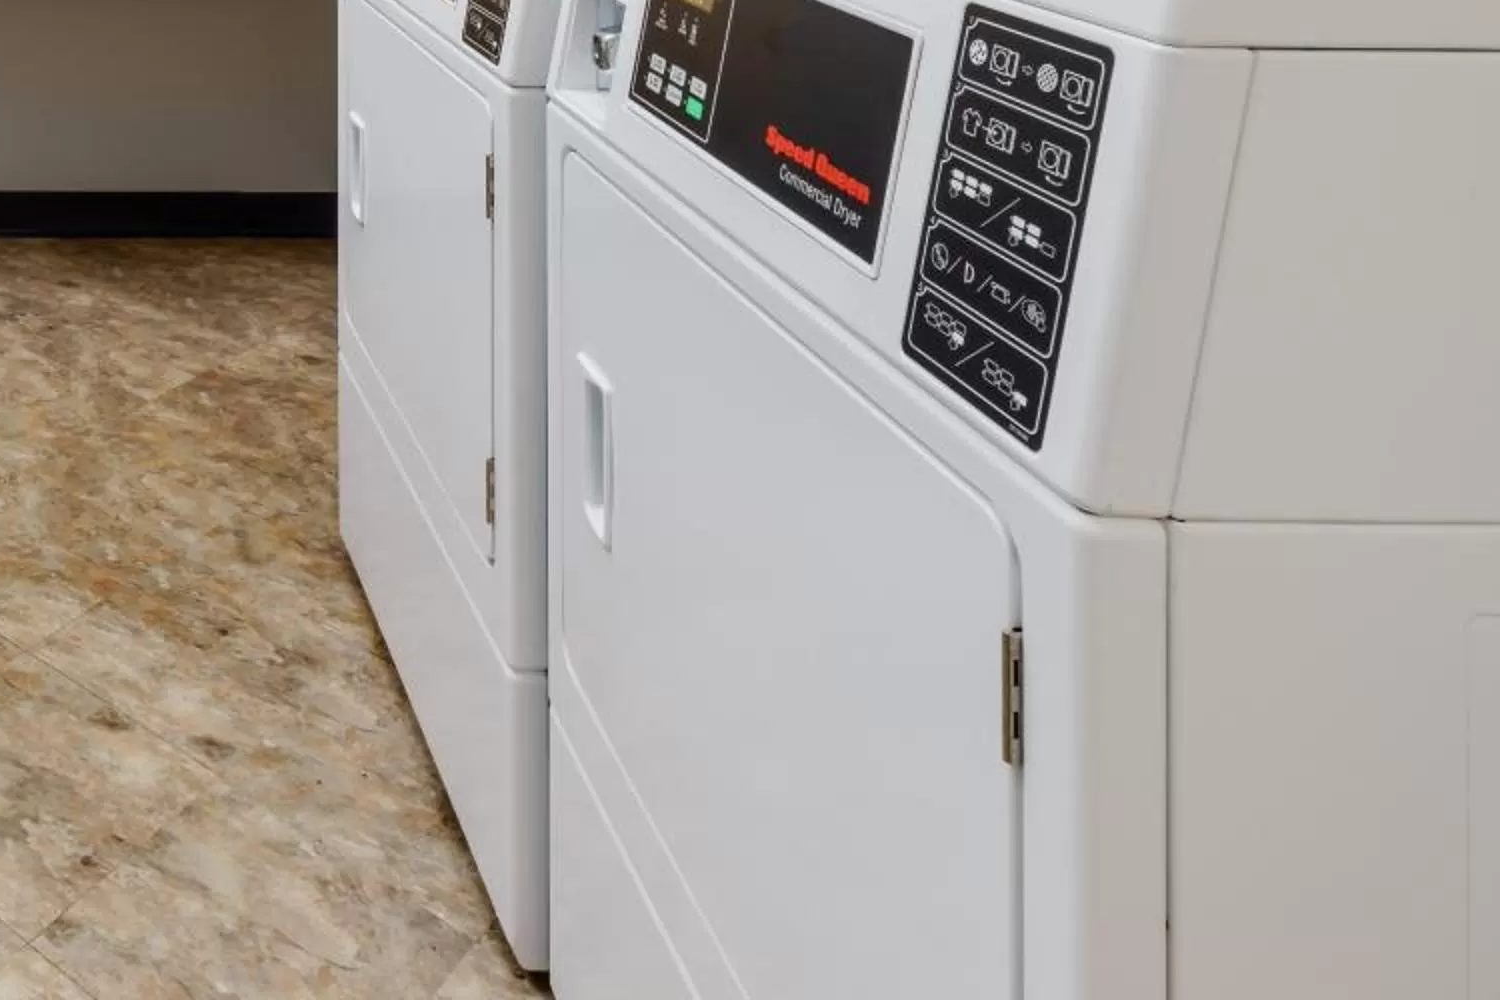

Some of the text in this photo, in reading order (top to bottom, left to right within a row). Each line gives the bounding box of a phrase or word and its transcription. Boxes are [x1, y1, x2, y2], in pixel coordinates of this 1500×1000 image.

[766, 124, 870, 206] Speed Queen
[779, 162, 862, 230] Commercial Dryer
